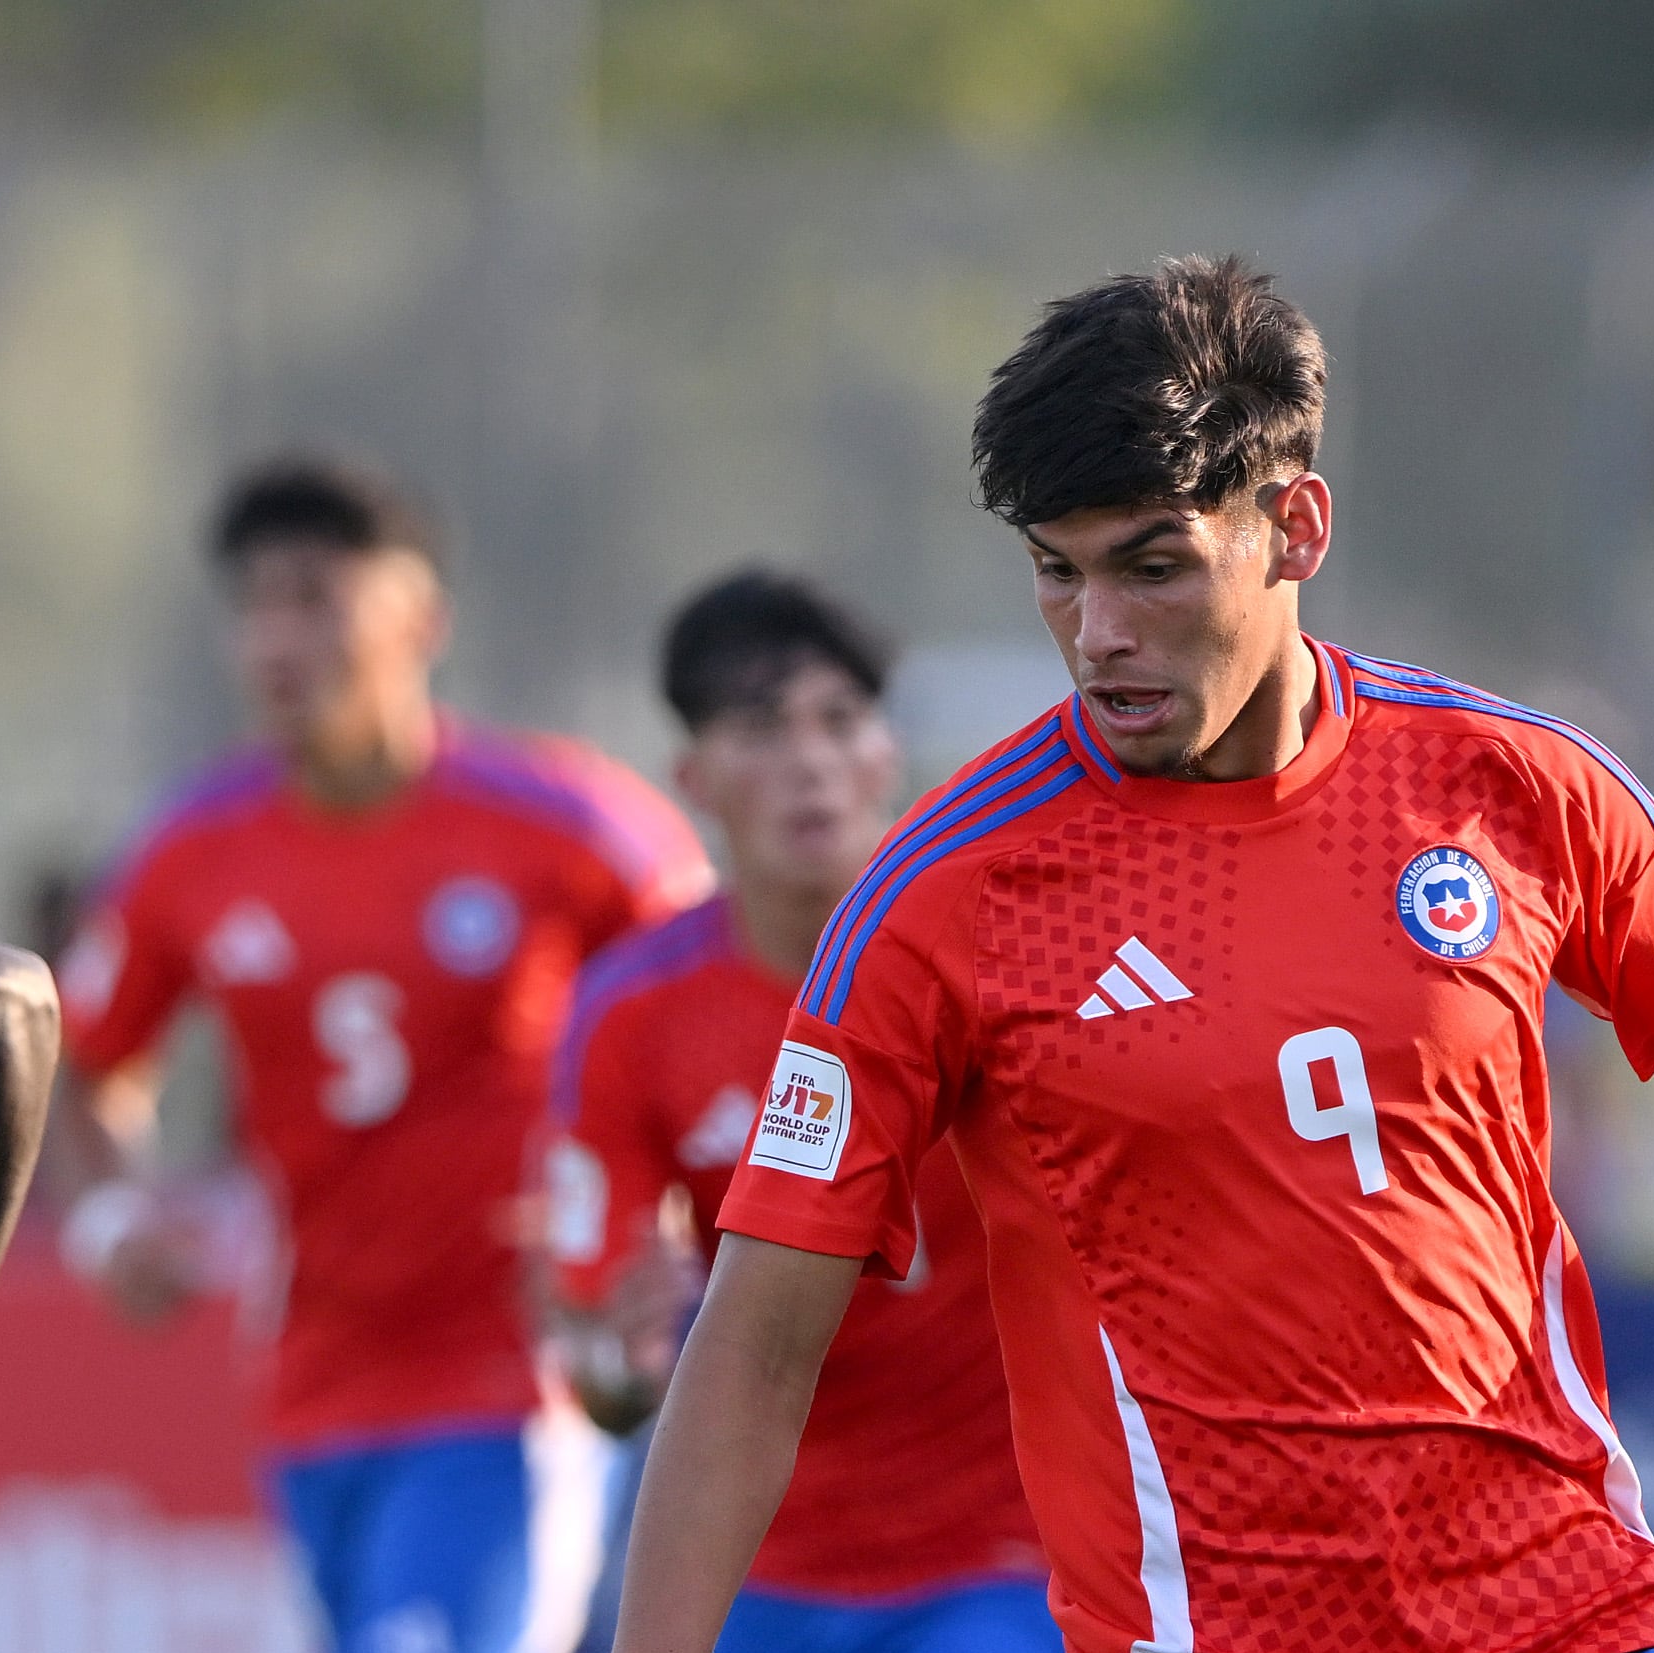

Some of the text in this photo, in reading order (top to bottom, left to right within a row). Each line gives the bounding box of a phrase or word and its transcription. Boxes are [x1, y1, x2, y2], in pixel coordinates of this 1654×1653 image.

[1400, 850, 1495, 915] FEDERACION DE FUTBOL
[1439, 934, 1490, 957] DE CHILE
[790, 1072, 815, 1088] FIFA
[1278, 1025, 1389, 1196] 9
[805, 1122, 831, 1136] CUP
[798, 1132, 824, 1146] 2025
